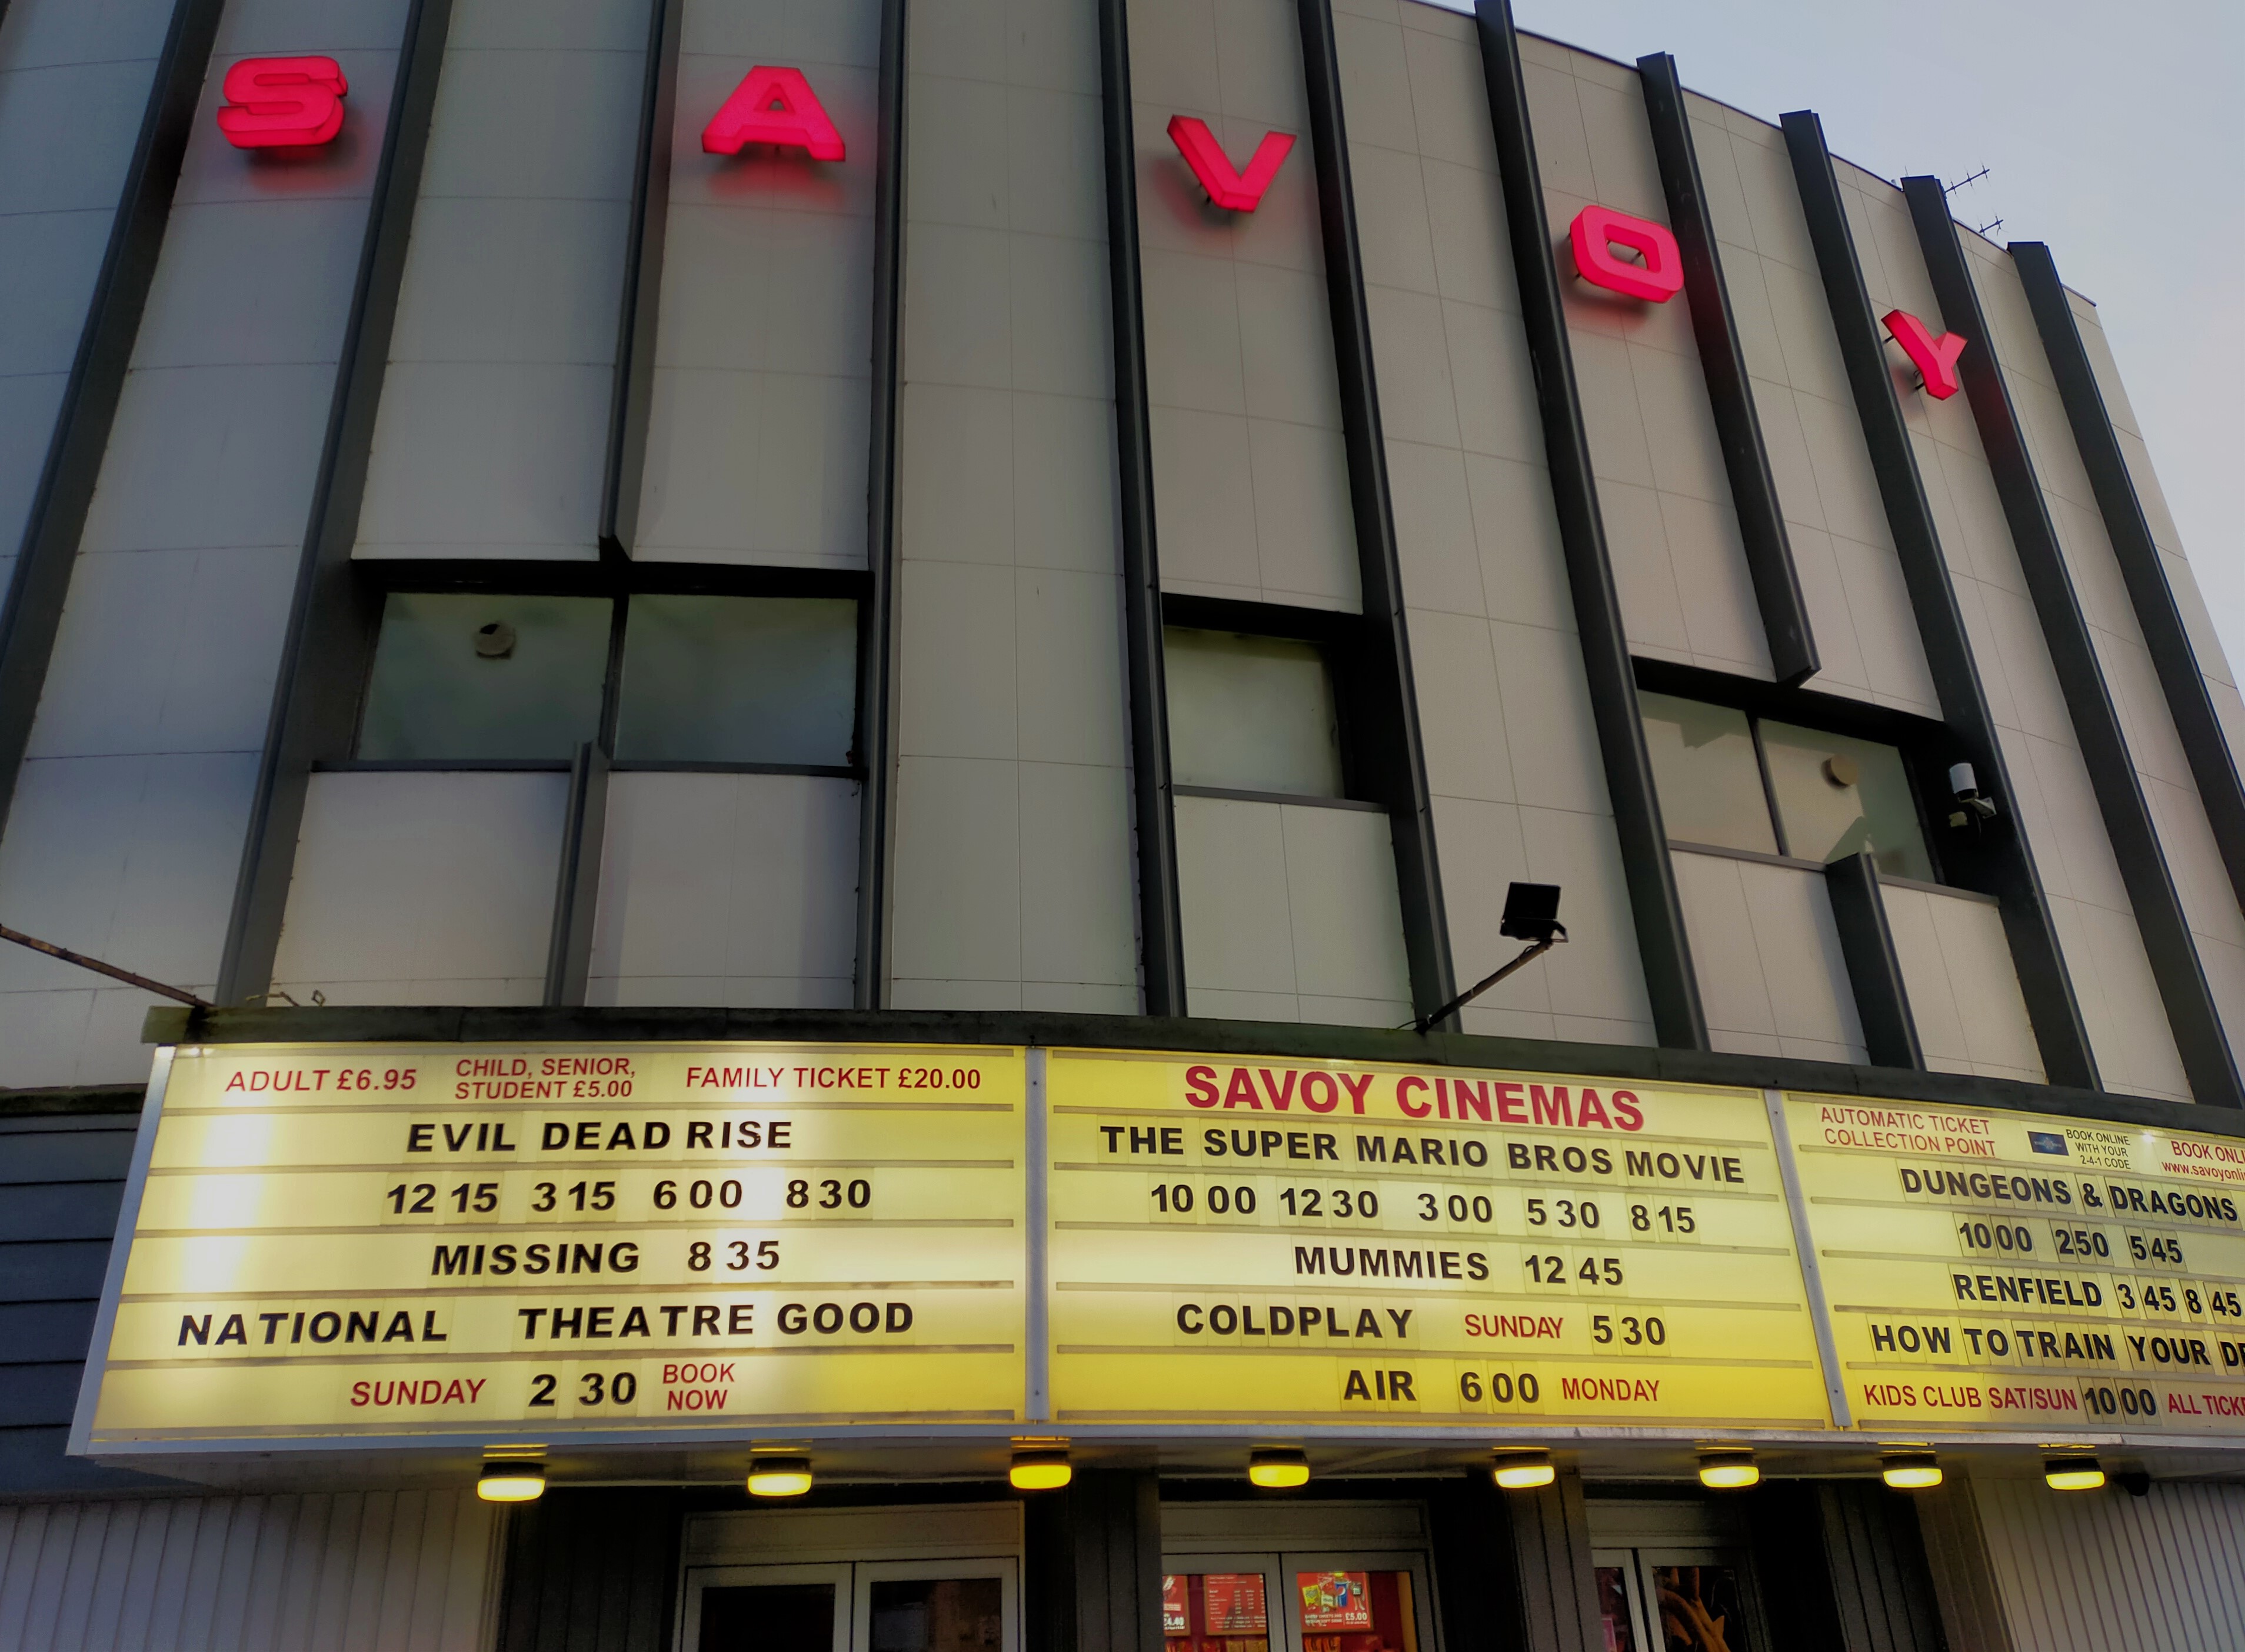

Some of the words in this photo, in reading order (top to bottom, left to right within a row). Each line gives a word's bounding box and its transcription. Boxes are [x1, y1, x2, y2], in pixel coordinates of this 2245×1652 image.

[216, 55, 1968, 401] SAVOY
[226, 1070, 330, 1091] ADULT
[337, 1069, 417, 1090] £6.95
[457, 1059, 532, 1078] CHILD,
[541, 1058, 634, 1077] SENIOR,
[687, 1067, 784, 1087] FAMILY
[794, 1068, 890, 1088] TICKET
[898, 1068, 980, 1088] £20.00
[455, 1081, 567, 1099] STUDENT
[574, 1080, 632, 1097] £5.00
[1185, 1066, 1374, 1114] SAVOY
[1395, 1076, 1645, 1131] CINEMAS
[1822, 1104, 1927, 1129] AUTOMATIC
[1928, 1115, 1989, 1134] TICKET
[407, 1123, 515, 1152] EVIL
[542, 1122, 670, 1150] DEAD
[687, 1121, 791, 1148] RISE
[1825, 1128, 1940, 1153] COLLECTION
[1945, 1137, 1994, 1156] POINT
[2066, 1129, 2094, 1141] BOOK
[2096, 1133, 2130, 1145] ONLINE
[2075, 1143, 2100, 1153] WITH
[2101, 1145, 2128, 1157] YOUR
[1100, 1126, 1183, 1154] THE
[1204, 1129, 1339, 1160] SUPER
[1356, 1135, 1487, 1167] MARIO
[1508, 1143, 1612, 1174] BROS
[1626, 1151, 1744, 1183] MOVIE
[2080, 1155, 2101, 1166] 2-4-1
[2104, 1158, 2131, 1169] CODE
[2171, 1141, 2213, 1160] BOOK
[2215, 1144, 2245, 1164] ONLI
[2161, 1162, 2244, 1181] www.savoyonli
[1901, 1169, 2071, 1204] DUNGEONS
[2080, 1183, 2103, 1208] &
[2109, 1185, 2237, 1221] DRAGONS
[432, 1243, 638, 1275] MISSING
[1295, 1247, 1488, 1280] MUMMIES
[1953, 1274, 2101, 1306] RENFIELD
[178, 1311, 447, 1345] NATIONAL
[518, 1305, 753, 1339] THEATRE
[778, 1303, 912, 1334] GOOD
[1177, 1304, 1412, 1338] COLDPLAY
[1465, 1314, 1563, 1338] SUNDAY
[1871, 1325, 1951, 1353] HOW
[1963, 1328, 2008, 1356] TO
[2016, 1331, 2115, 1362] TRAIN
[2126, 1336, 2211, 1365] YOUR
[663, 1364, 734, 1384] BOOK
[1344, 1370, 1416, 1401] AIR
[1562, 1378, 1659, 1401] MONDAY
[351, 1379, 486, 1406] SUNDAY
[668, 1390, 727, 1410] NOW
[1864, 1385, 1916, 1406] KIDS
[1924, 1386, 1981, 1407] CLUB
[1989, 1388, 2077, 1410] SAT/SUN
[2169, 1394, 2201, 1414] ALL
